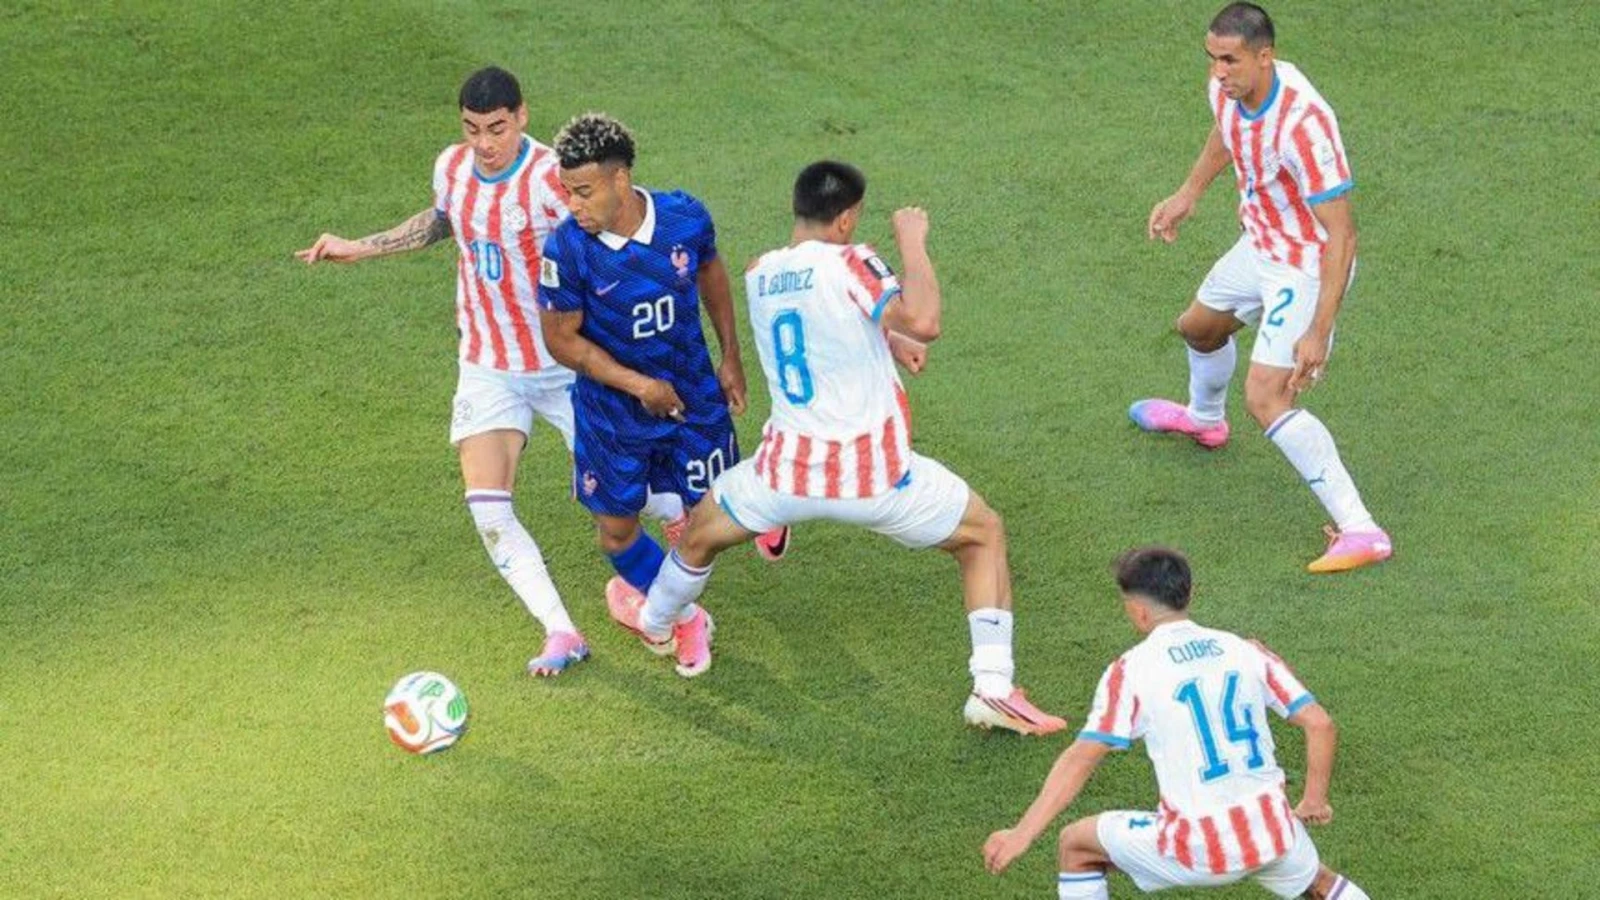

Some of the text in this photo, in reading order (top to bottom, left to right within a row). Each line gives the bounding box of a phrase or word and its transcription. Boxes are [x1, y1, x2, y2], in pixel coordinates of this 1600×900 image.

[470, 240, 501, 281] 10
[632, 294, 675, 340] 20
[1266, 287, 1294, 327] 2
[771, 308, 815, 406] 8
[686, 447, 724, 493] 20
[1167, 638, 1225, 664] CUBAS
[1175, 671, 1265, 782] 14
